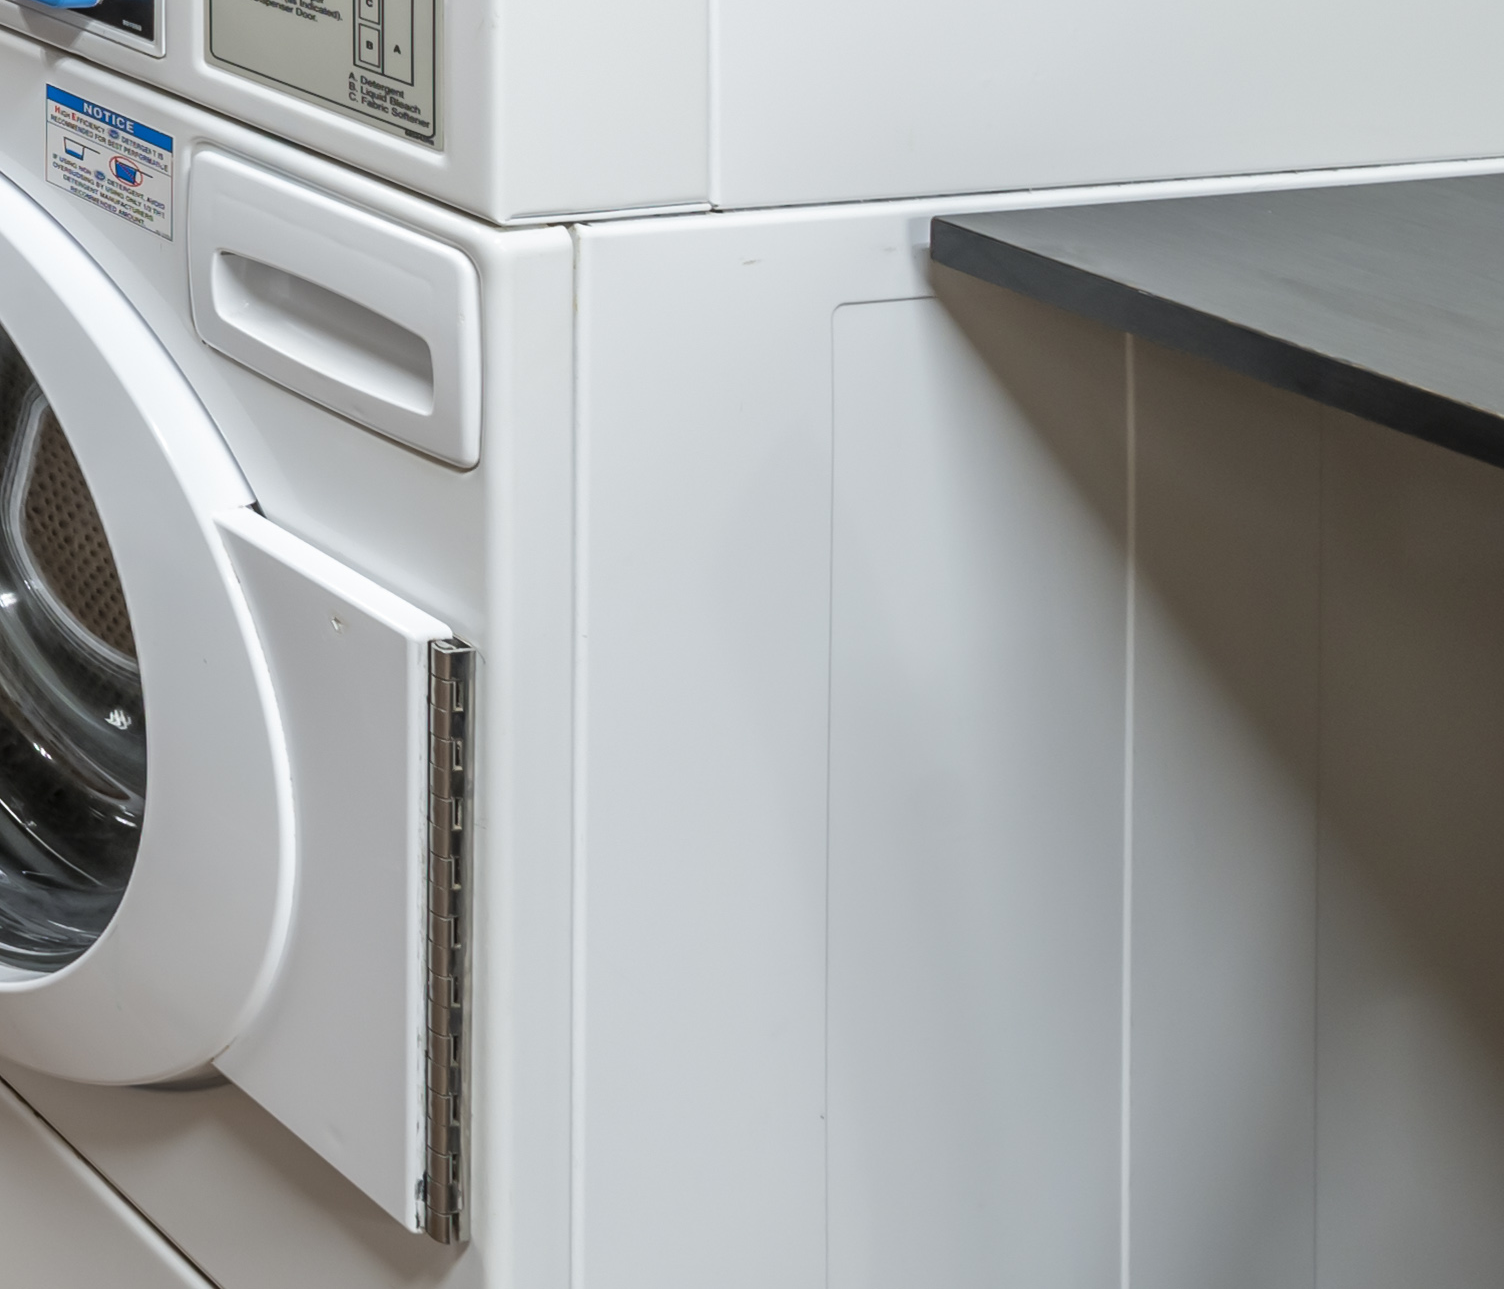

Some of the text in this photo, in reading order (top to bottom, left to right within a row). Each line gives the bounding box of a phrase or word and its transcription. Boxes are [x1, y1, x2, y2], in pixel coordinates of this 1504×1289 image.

[366, 41, 373, 50] B
[393, 44, 402, 54] A
[360, 75, 405, 99] Detergent
[360, 86, 388, 102] Liquid
[389, 97, 421, 115] Bleach
[361, 96, 389, 114] Fabric
[391, 108, 430, 129] Softener
[83, 102, 135, 134] NOTICE
